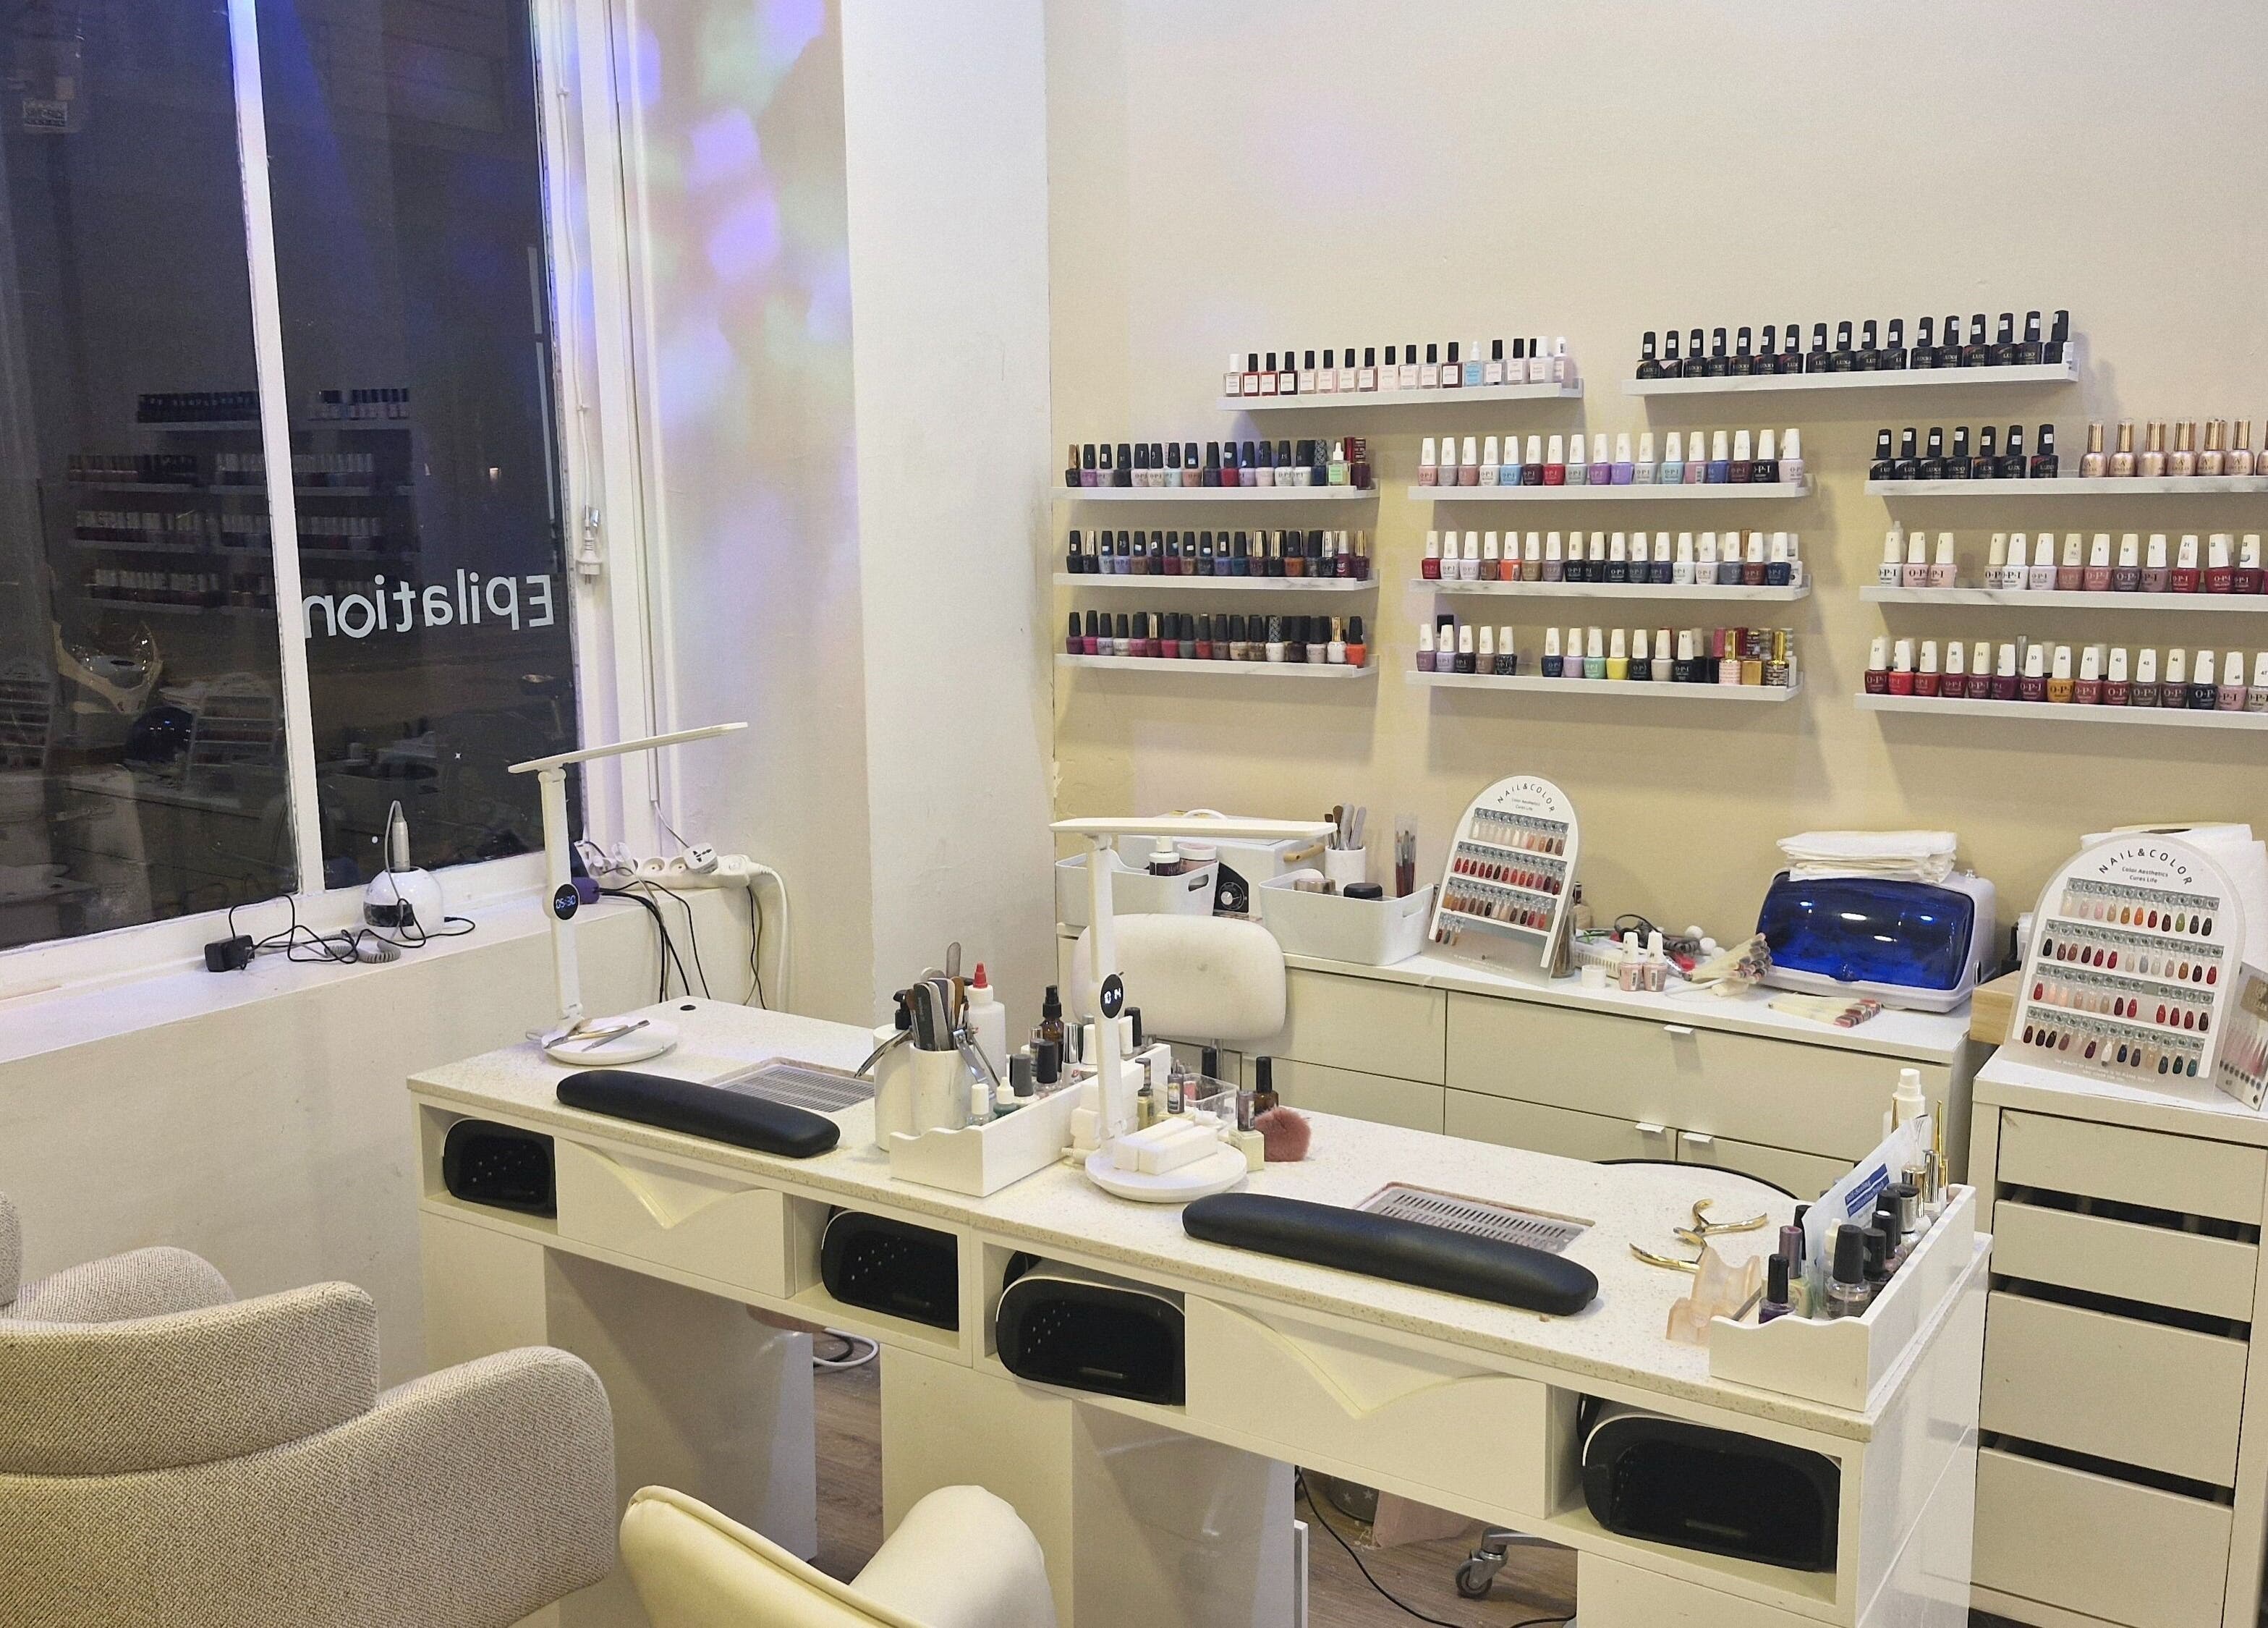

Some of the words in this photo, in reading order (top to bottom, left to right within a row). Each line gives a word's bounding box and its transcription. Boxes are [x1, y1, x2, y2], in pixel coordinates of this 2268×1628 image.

[1498, 783, 1555, 812] NAIL&COLOR
[2099, 848, 2192, 885] NAIL&COLOR
[2139, 868, 2169, 877] Aesthetics
